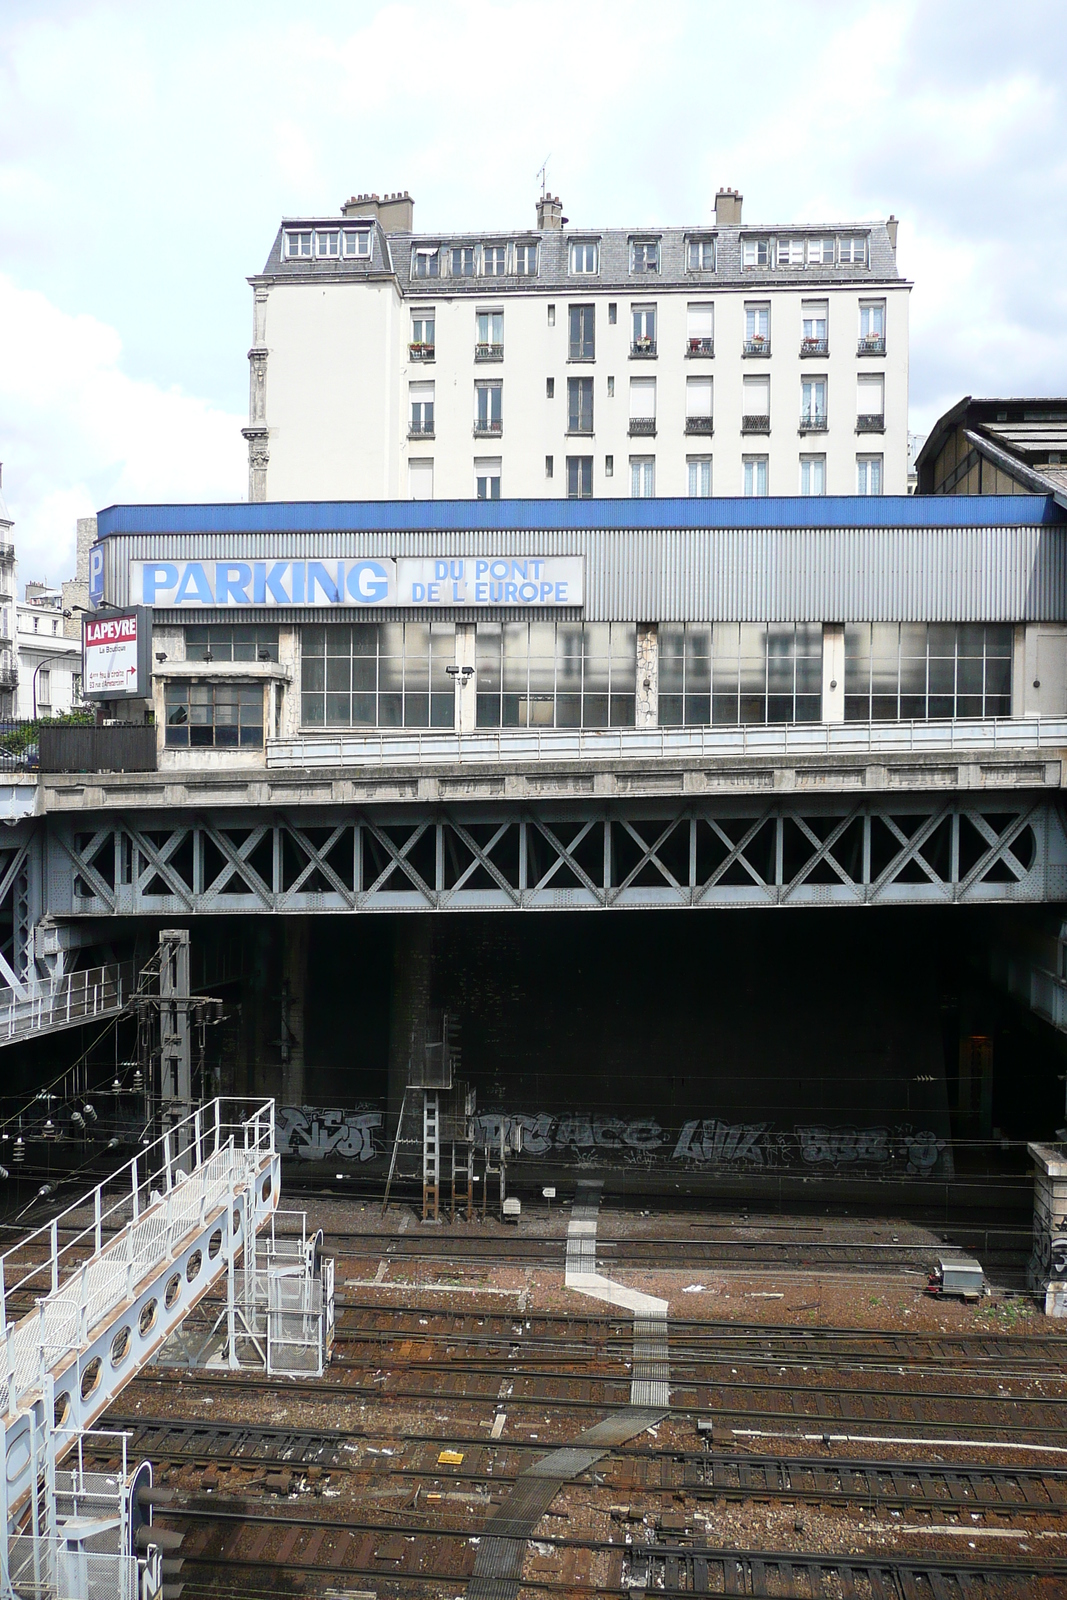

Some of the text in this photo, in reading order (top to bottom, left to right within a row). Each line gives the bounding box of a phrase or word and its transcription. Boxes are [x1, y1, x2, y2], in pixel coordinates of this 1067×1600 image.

[91, 549, 103, 593] P
[435, 559, 545, 581] DU PONT
[143, 561, 389, 604] PARKING
[412, 582, 440, 602] DE
[87, 618, 136, 641] LAPEYRE
